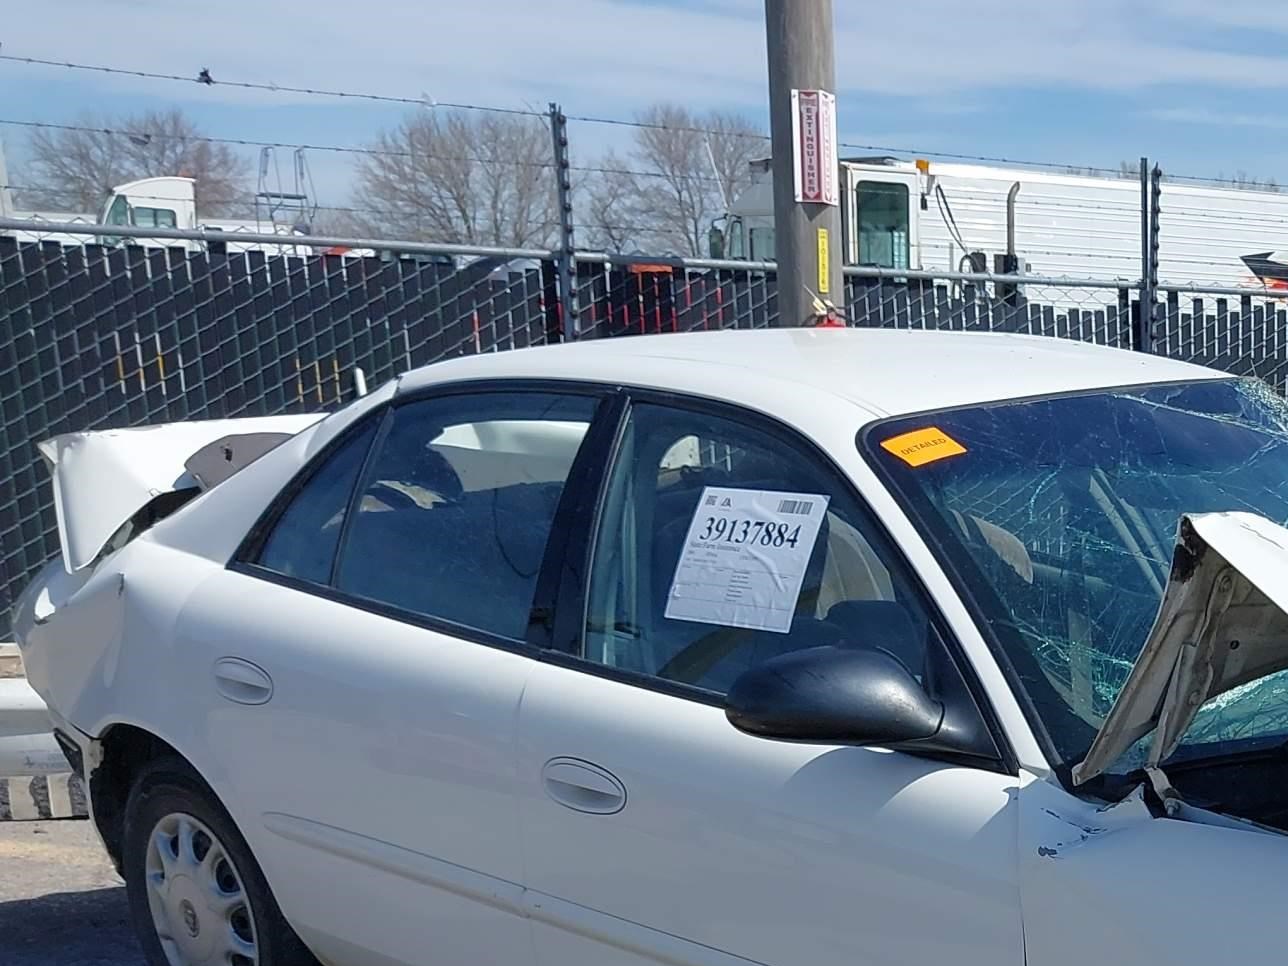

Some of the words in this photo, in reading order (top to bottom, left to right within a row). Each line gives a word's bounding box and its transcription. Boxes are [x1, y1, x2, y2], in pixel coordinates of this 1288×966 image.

[805, 107, 815, 193] EXTINGUISHER
[900, 438, 947, 456] DETAILED
[699, 516, 802, 549] 39137884
